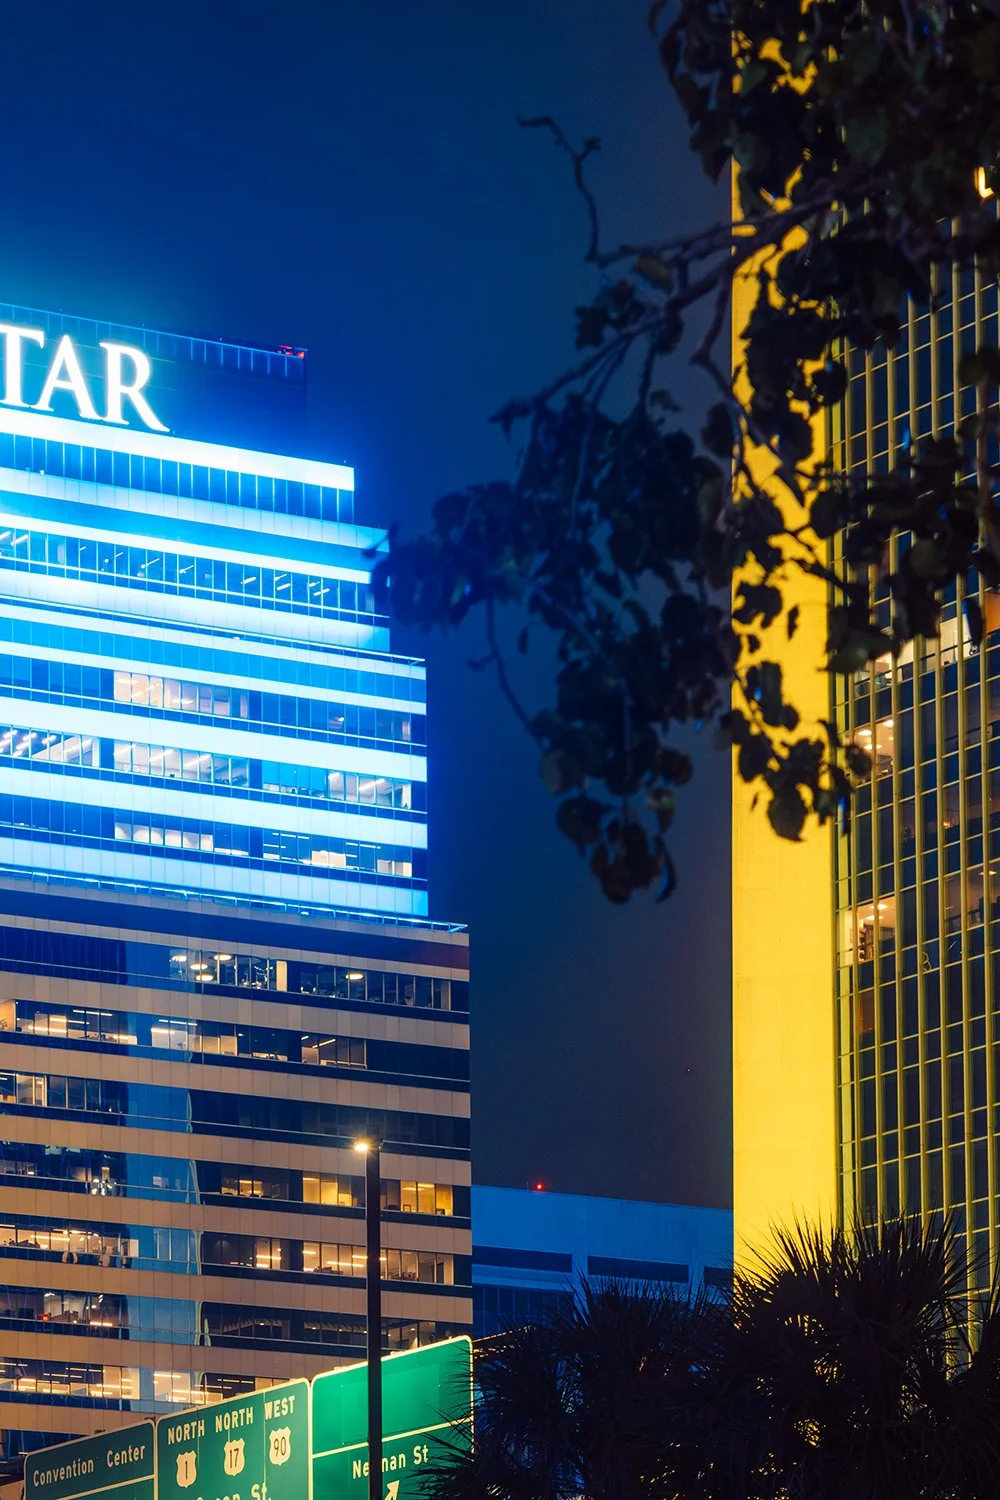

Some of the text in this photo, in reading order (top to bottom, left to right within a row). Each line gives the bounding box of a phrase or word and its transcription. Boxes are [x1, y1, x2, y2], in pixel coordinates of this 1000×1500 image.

[167, 1395, 296, 1445] NORTH NORTH WEST
[33, 1444, 146, 1487] Convention Center
[229, 1447, 240, 1469] 17
[273, 1435, 287, 1457] 90
[352, 1444, 429, 1479] Nenan St
